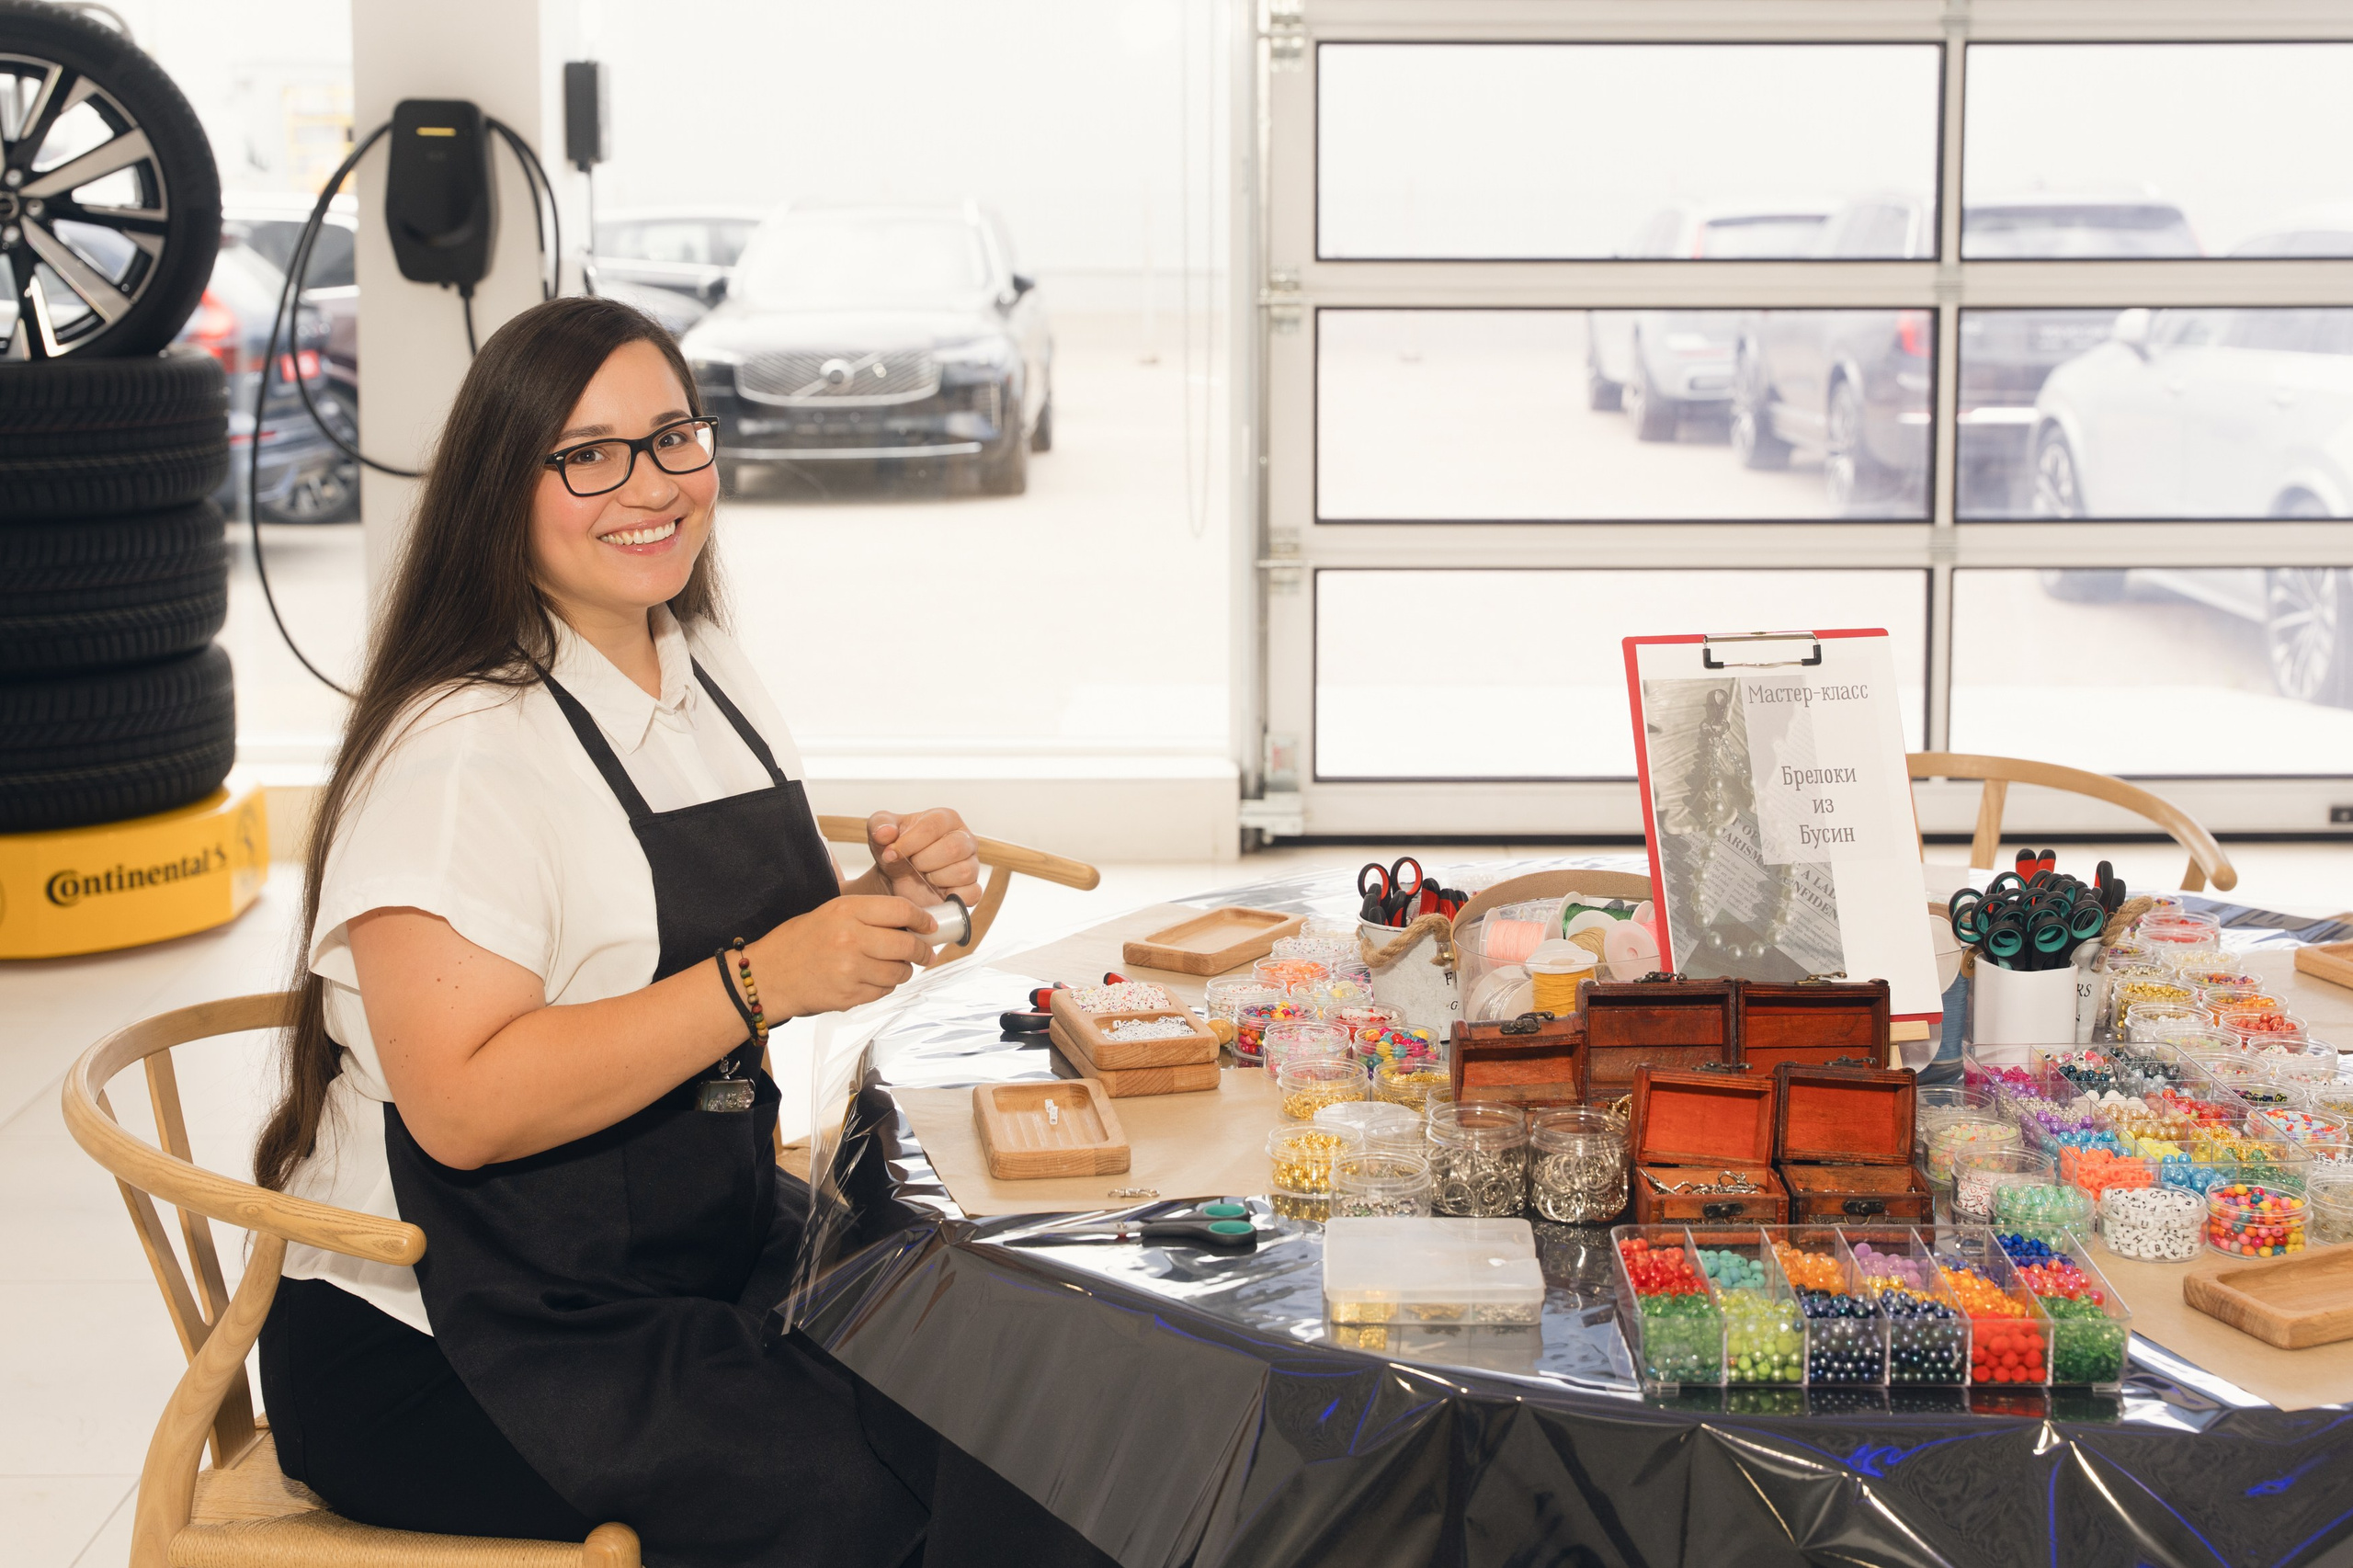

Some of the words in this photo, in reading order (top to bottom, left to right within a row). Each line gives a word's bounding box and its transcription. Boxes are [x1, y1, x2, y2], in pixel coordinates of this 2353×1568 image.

[1748, 684, 1869, 708] Мастер-класс
[1781, 766, 1857, 791] Брелоки
[1813, 799, 1835, 814] из
[1800, 824, 1856, 849] Бусин
[46, 846, 210, 908] Continental
